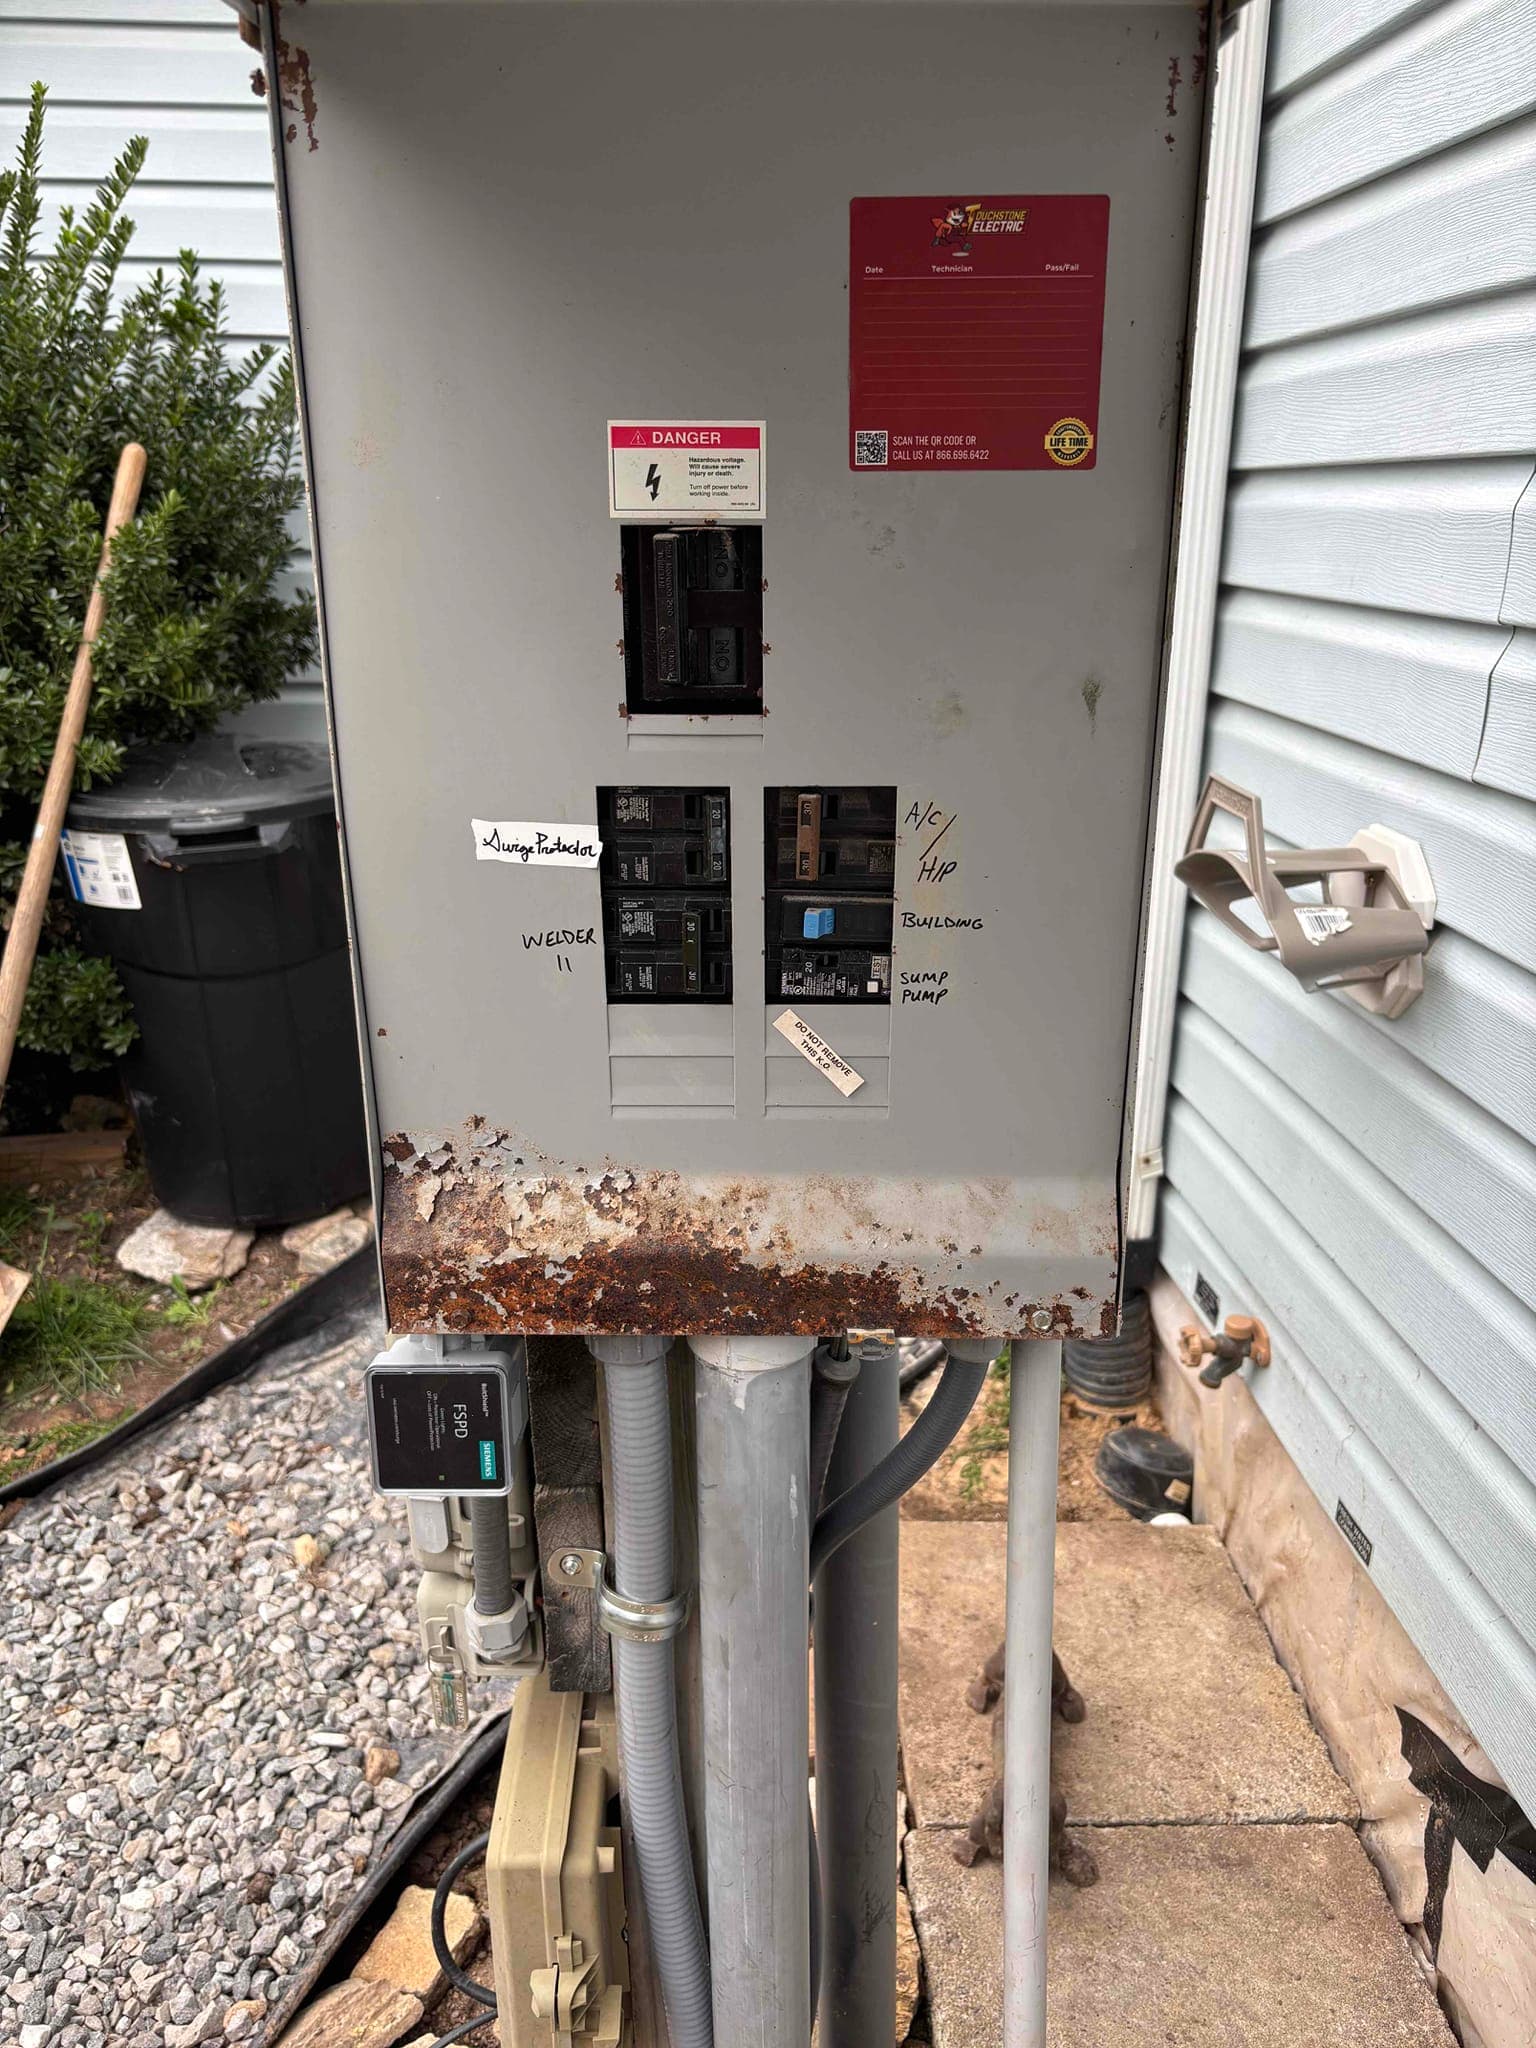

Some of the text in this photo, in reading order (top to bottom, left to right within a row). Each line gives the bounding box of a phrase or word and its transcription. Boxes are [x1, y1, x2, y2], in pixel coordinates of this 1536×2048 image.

[965, 203, 1027, 230] TOUCHSTONE
[972, 220, 1025, 233] ELECTRIC
[865, 266, 884, 274] Date
[931, 264, 973, 273] Technician
[1045, 263, 1080, 272] Pass/Fail
[652, 431, 721, 445] DANGER
[892, 435, 977, 447] SCAN THE QR CODE OR
[1050, 437, 1089, 447] LIFE TIME
[722, 456, 746, 465] voltage.
[892, 450, 911, 460] CALL
[912, 450, 923, 460] US
[925, 450, 934, 460] AT
[714, 544, 729, 578] ON
[715, 639, 730, 672] ON
[712, 809, 721, 819] 20
[803, 803, 812, 816] 30
[713, 861, 722, 871] 20
[801, 860, 810, 873] 30
[918, 862, 958, 883] H/P
[687, 921, 695, 932] 30
[900, 912, 984, 930] BUILDING
[522, 927, 597, 949] WELDER
[805, 961, 813, 973] 20
[872, 957, 881, 978] TEST
[688, 971, 697, 981] 30
[900, 970, 949, 985] SUMP
[901, 987, 949, 1006] PUMP
[795, 1021, 852, 1077] DO NOT REMOVE
[801, 1038, 831, 1071] THIS K.O.
[453, 1403, 468, 1439] FSPD
[483, 1442, 492, 1478] SIEMENS
